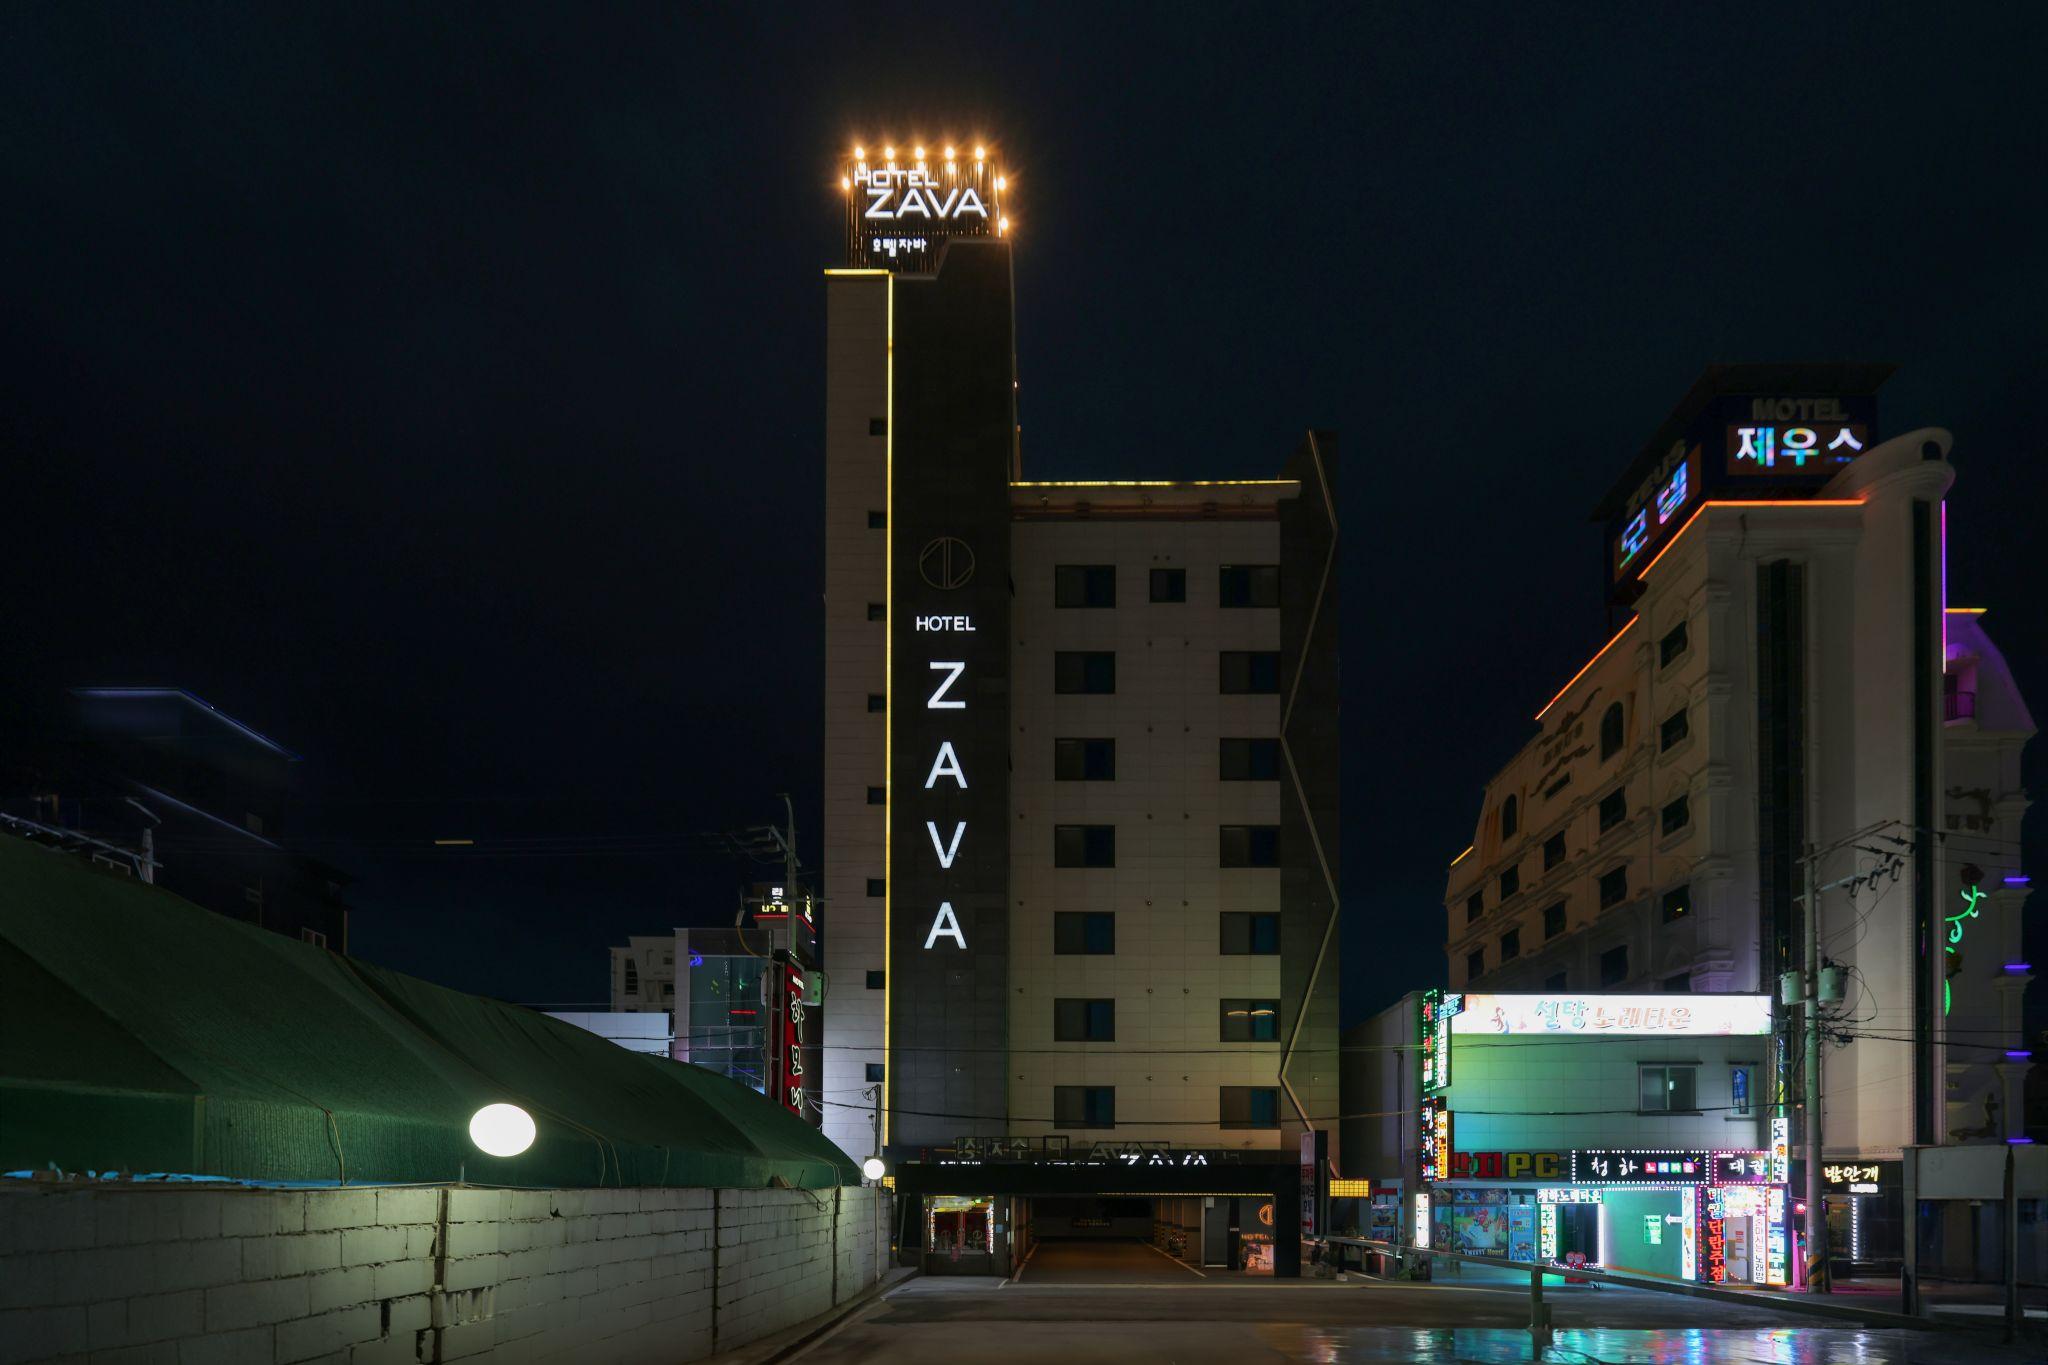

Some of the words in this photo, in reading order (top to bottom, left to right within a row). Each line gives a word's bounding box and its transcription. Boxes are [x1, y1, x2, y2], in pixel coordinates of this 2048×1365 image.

[854, 169, 939, 188] HOTEL
[864, 188, 988, 218] ZAVA
[1751, 398, 1849, 421] MOTEL
[1735, 426, 1863, 467] 제우스
[1619, 460, 1688, 570] 모텔
[915, 616, 976, 631] HOTEL
[923, 661, 968, 950] ZAVA
[1595, 1007, 1691, 1029] 노래타운
[1507, 1153, 1560, 1178] PC
[1824, 1165, 1879, 1184] 밤안개
[1707, 1220, 1725, 1281] 단란주점
